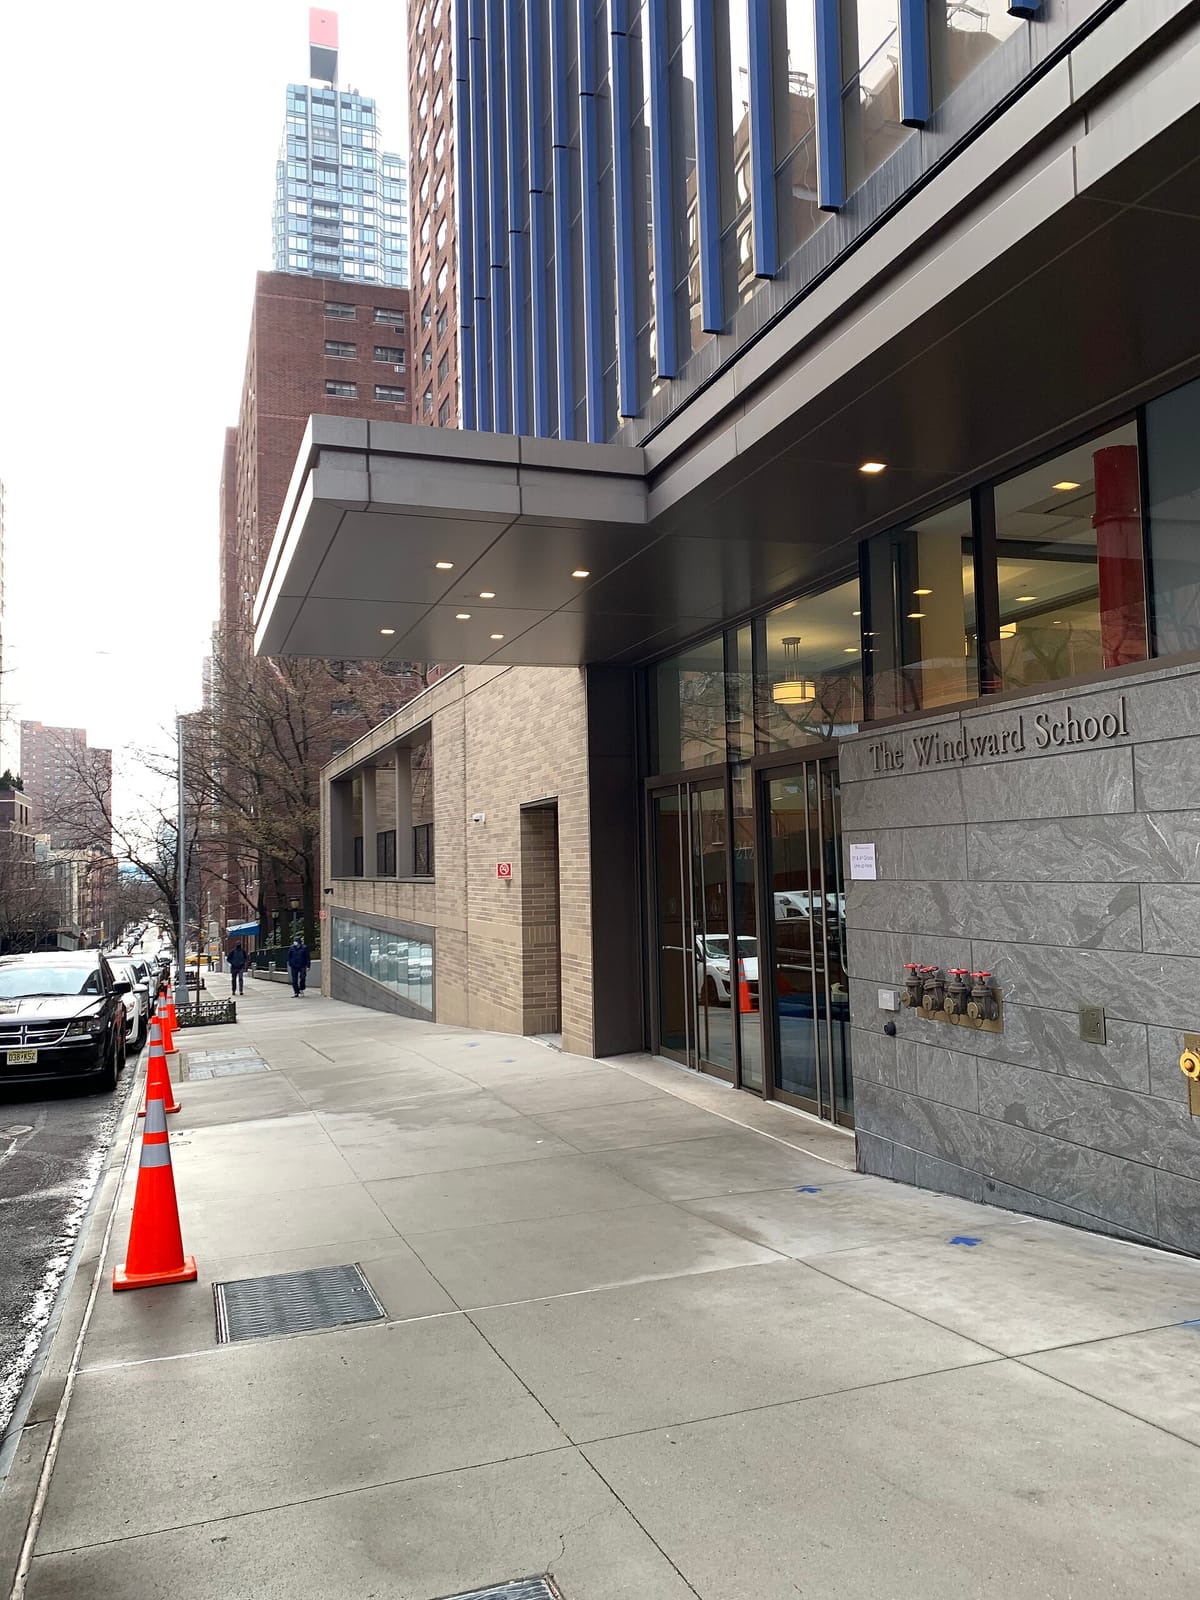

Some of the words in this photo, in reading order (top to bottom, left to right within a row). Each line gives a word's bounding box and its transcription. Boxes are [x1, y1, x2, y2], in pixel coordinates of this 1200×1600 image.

[869, 742, 904, 773] The
[911, 716, 1024, 767] Windward
[1033, 696, 1128, 749] School
